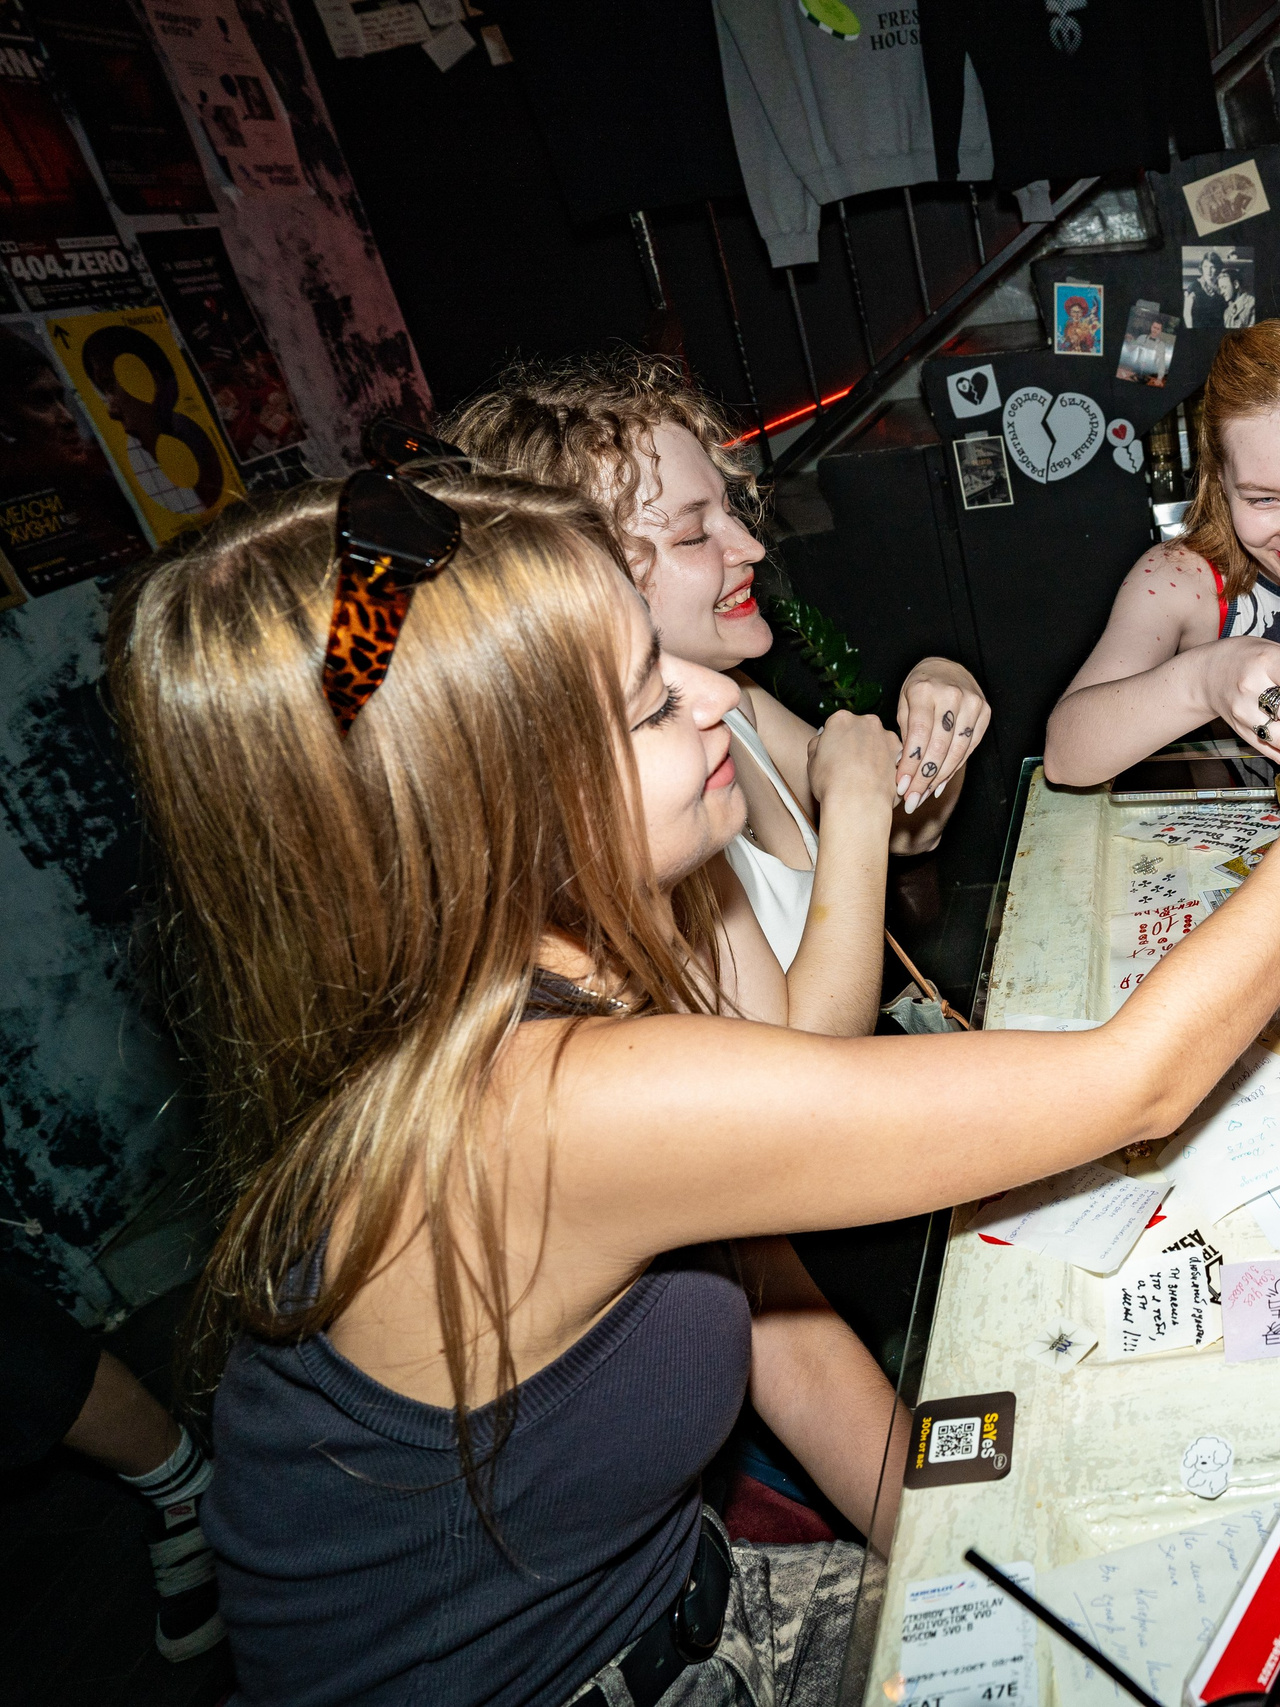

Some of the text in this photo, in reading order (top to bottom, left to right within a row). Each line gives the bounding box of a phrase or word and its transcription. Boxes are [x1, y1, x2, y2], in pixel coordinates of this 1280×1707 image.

[9, 249, 131, 282] 404.ZERO
[1007, 390, 1047, 480] разбитых сердец
[1049, 395, 1100, 474] бильярдный бар
[981, 1680, 1020, 1702] 47E
